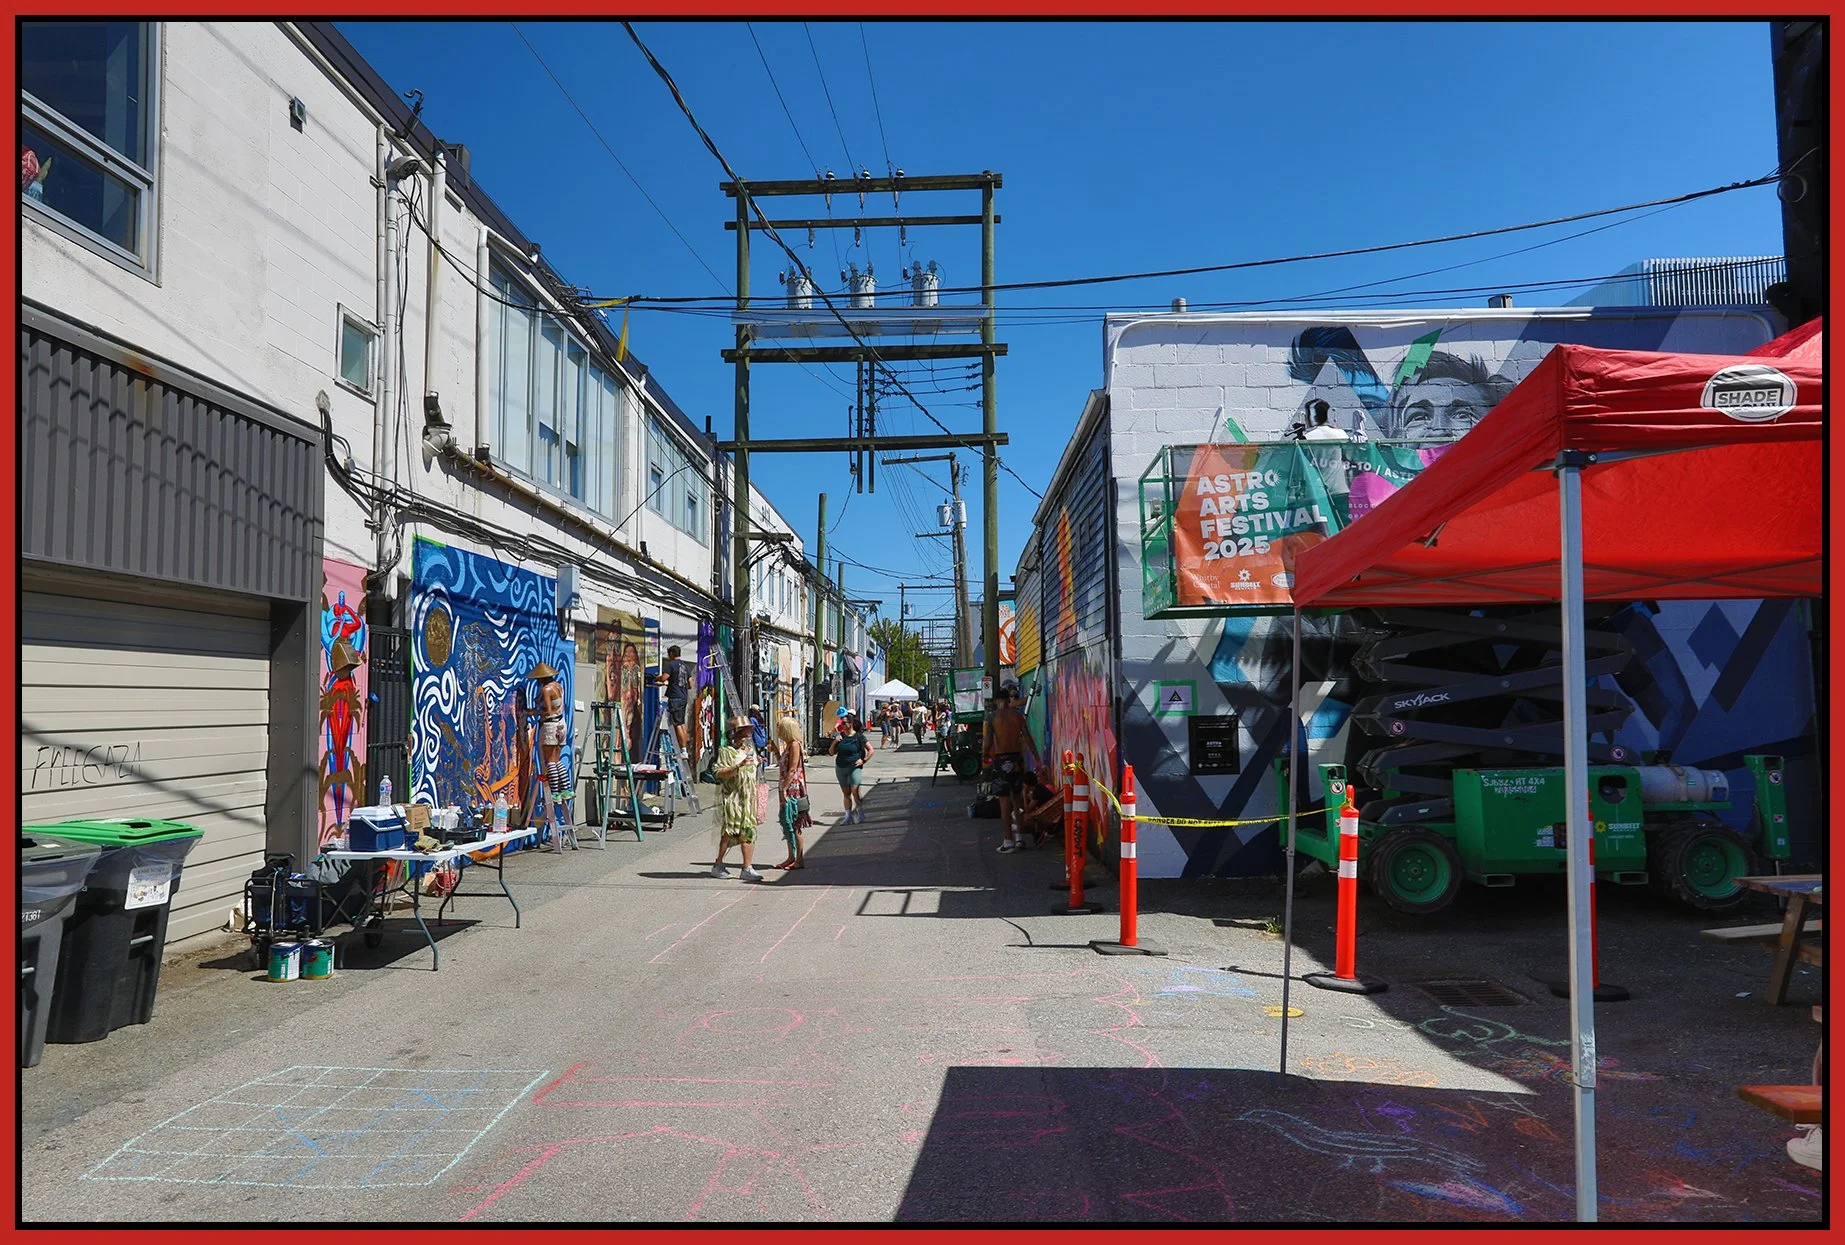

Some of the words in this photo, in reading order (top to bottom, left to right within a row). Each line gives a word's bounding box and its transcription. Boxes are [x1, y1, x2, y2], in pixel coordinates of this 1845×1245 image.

[1718, 390, 1778, 404] SHADE
[1311, 457, 1338, 468] AUG
[1197, 469, 1280, 496] ASTRO
[1200, 492, 1270, 517] ARTS
[1200, 504, 1328, 539] FESTIVAL
[1203, 535, 1271, 560] 2025
[1394, 693, 1451, 709] SKYJACK
[1528, 777, 1545, 785] 4X4
